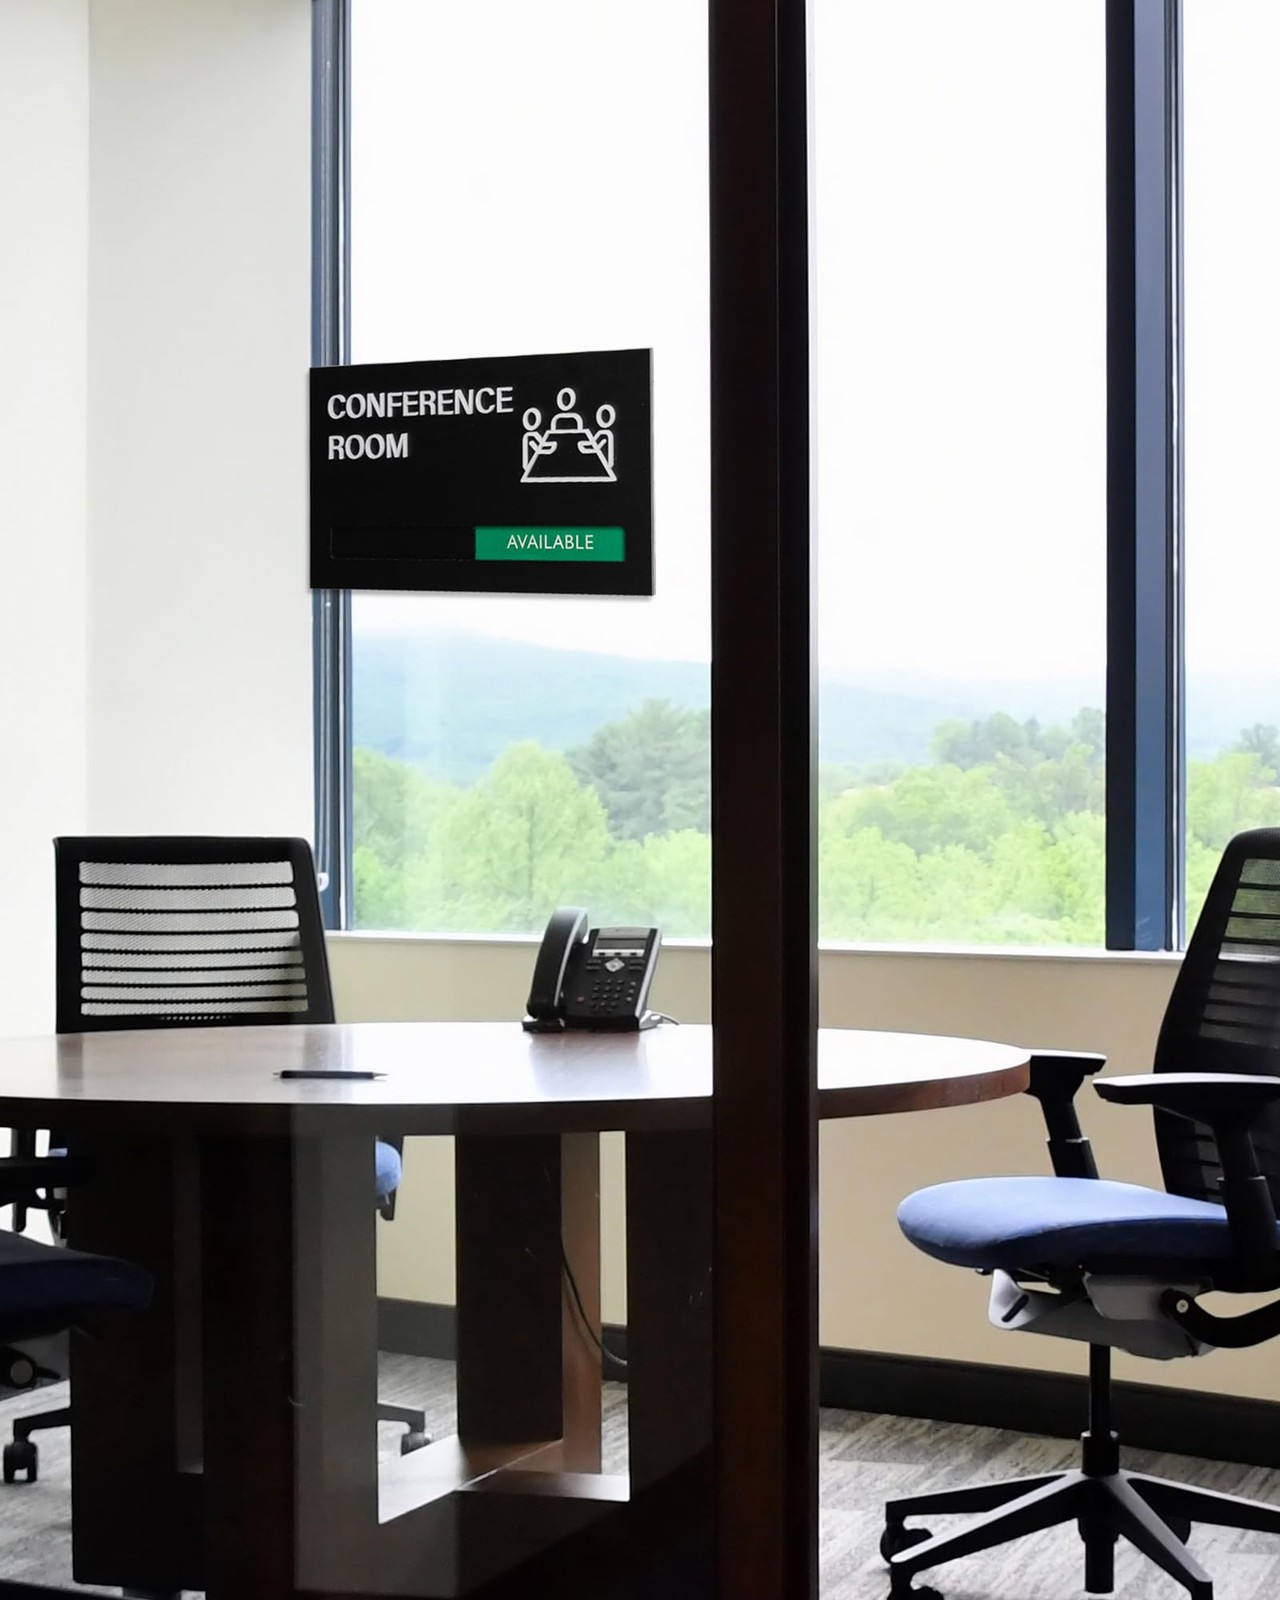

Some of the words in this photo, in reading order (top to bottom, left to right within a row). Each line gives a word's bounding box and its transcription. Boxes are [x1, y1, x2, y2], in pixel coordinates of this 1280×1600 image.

[327, 386, 514, 420] CONFERENCE
[328, 432, 409, 461] ROOM
[507, 534, 594, 550] AVAILABLE
